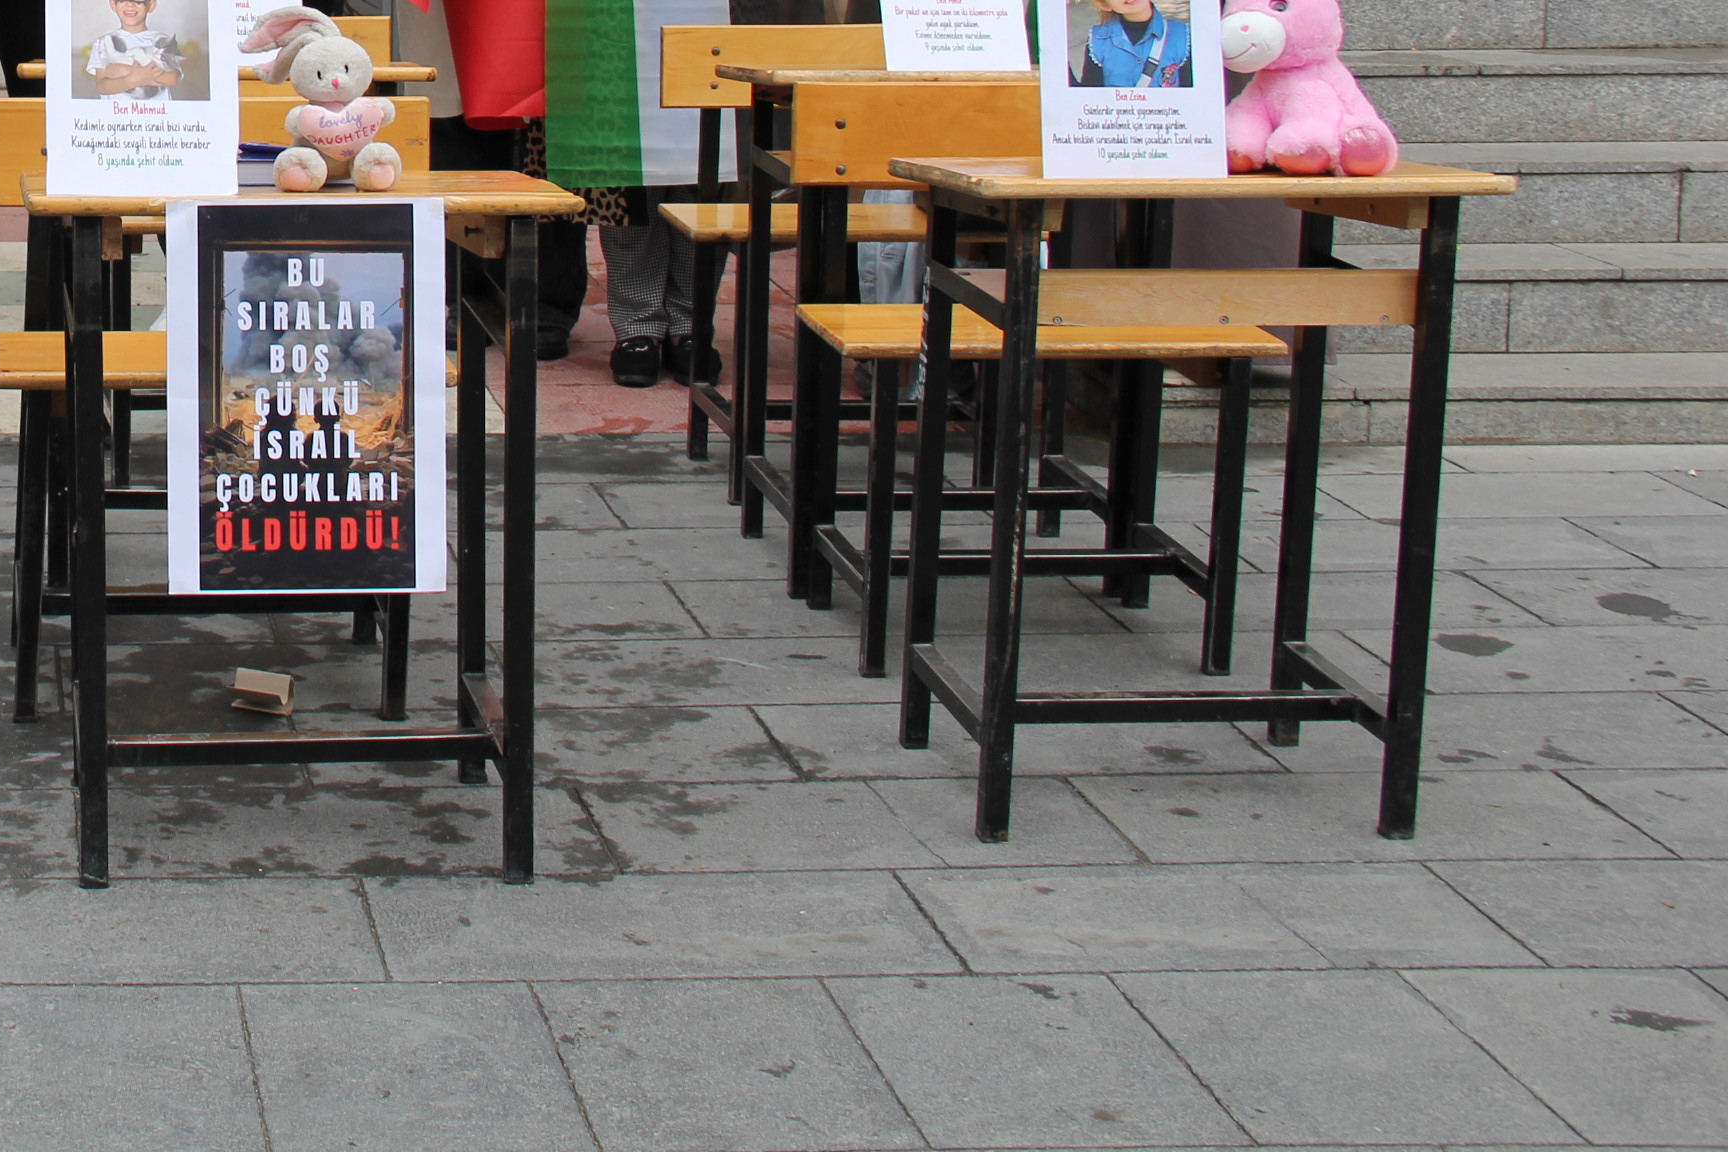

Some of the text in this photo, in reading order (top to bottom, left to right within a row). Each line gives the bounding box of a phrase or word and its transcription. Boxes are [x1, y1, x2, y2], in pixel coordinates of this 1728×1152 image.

[895, 6, 904, 15] Bir
[1116, 90, 1128, 101] Ben
[113, 101, 168, 114] Ben Mahmud.
[1083, 104, 1114, 115] Günlerdir
[1115, 104, 1136, 120] yemek
[74, 118, 207, 136] Kedimle oynarken israil bizi vurdu.
[319, 111, 363, 128] lovely
[1078, 118, 1100, 130] Bisküvi
[1102, 119, 1131, 130] alabilmek
[1132, 122, 1143, 131] için
[1145, 123, 1163, 134] sıraya
[71, 135, 211, 154] Kucağımdaki sevgili kedimle beraber
[1052, 133, 1072, 144] Ancak
[1073, 133, 1094, 144] bisküvi
[1096, 134, 1129, 144] sırasındaki
[1130, 136, 1143, 144] tüm
[1145, 134, 1172, 146] çocukları
[98, 153, 184, 171] 8 yaşında şehit oldum.
[1098, 148, 1105, 158] 10
[1107, 148, 1130, 163] yaşında
[1132, 148, 1146, 160] şehit
[288, 258, 324, 287] BU
[237, 300, 375, 330] SIRALAR
[270, 344, 329, 382] BOŞ
[255, 380, 358, 426] ÇÜNKÜ
[253, 424, 361, 460] İSRAİL
[216, 472, 398, 512] ÇOCUKLARI
[215, 510, 400, 552] ÖLDÜRDÜ!
